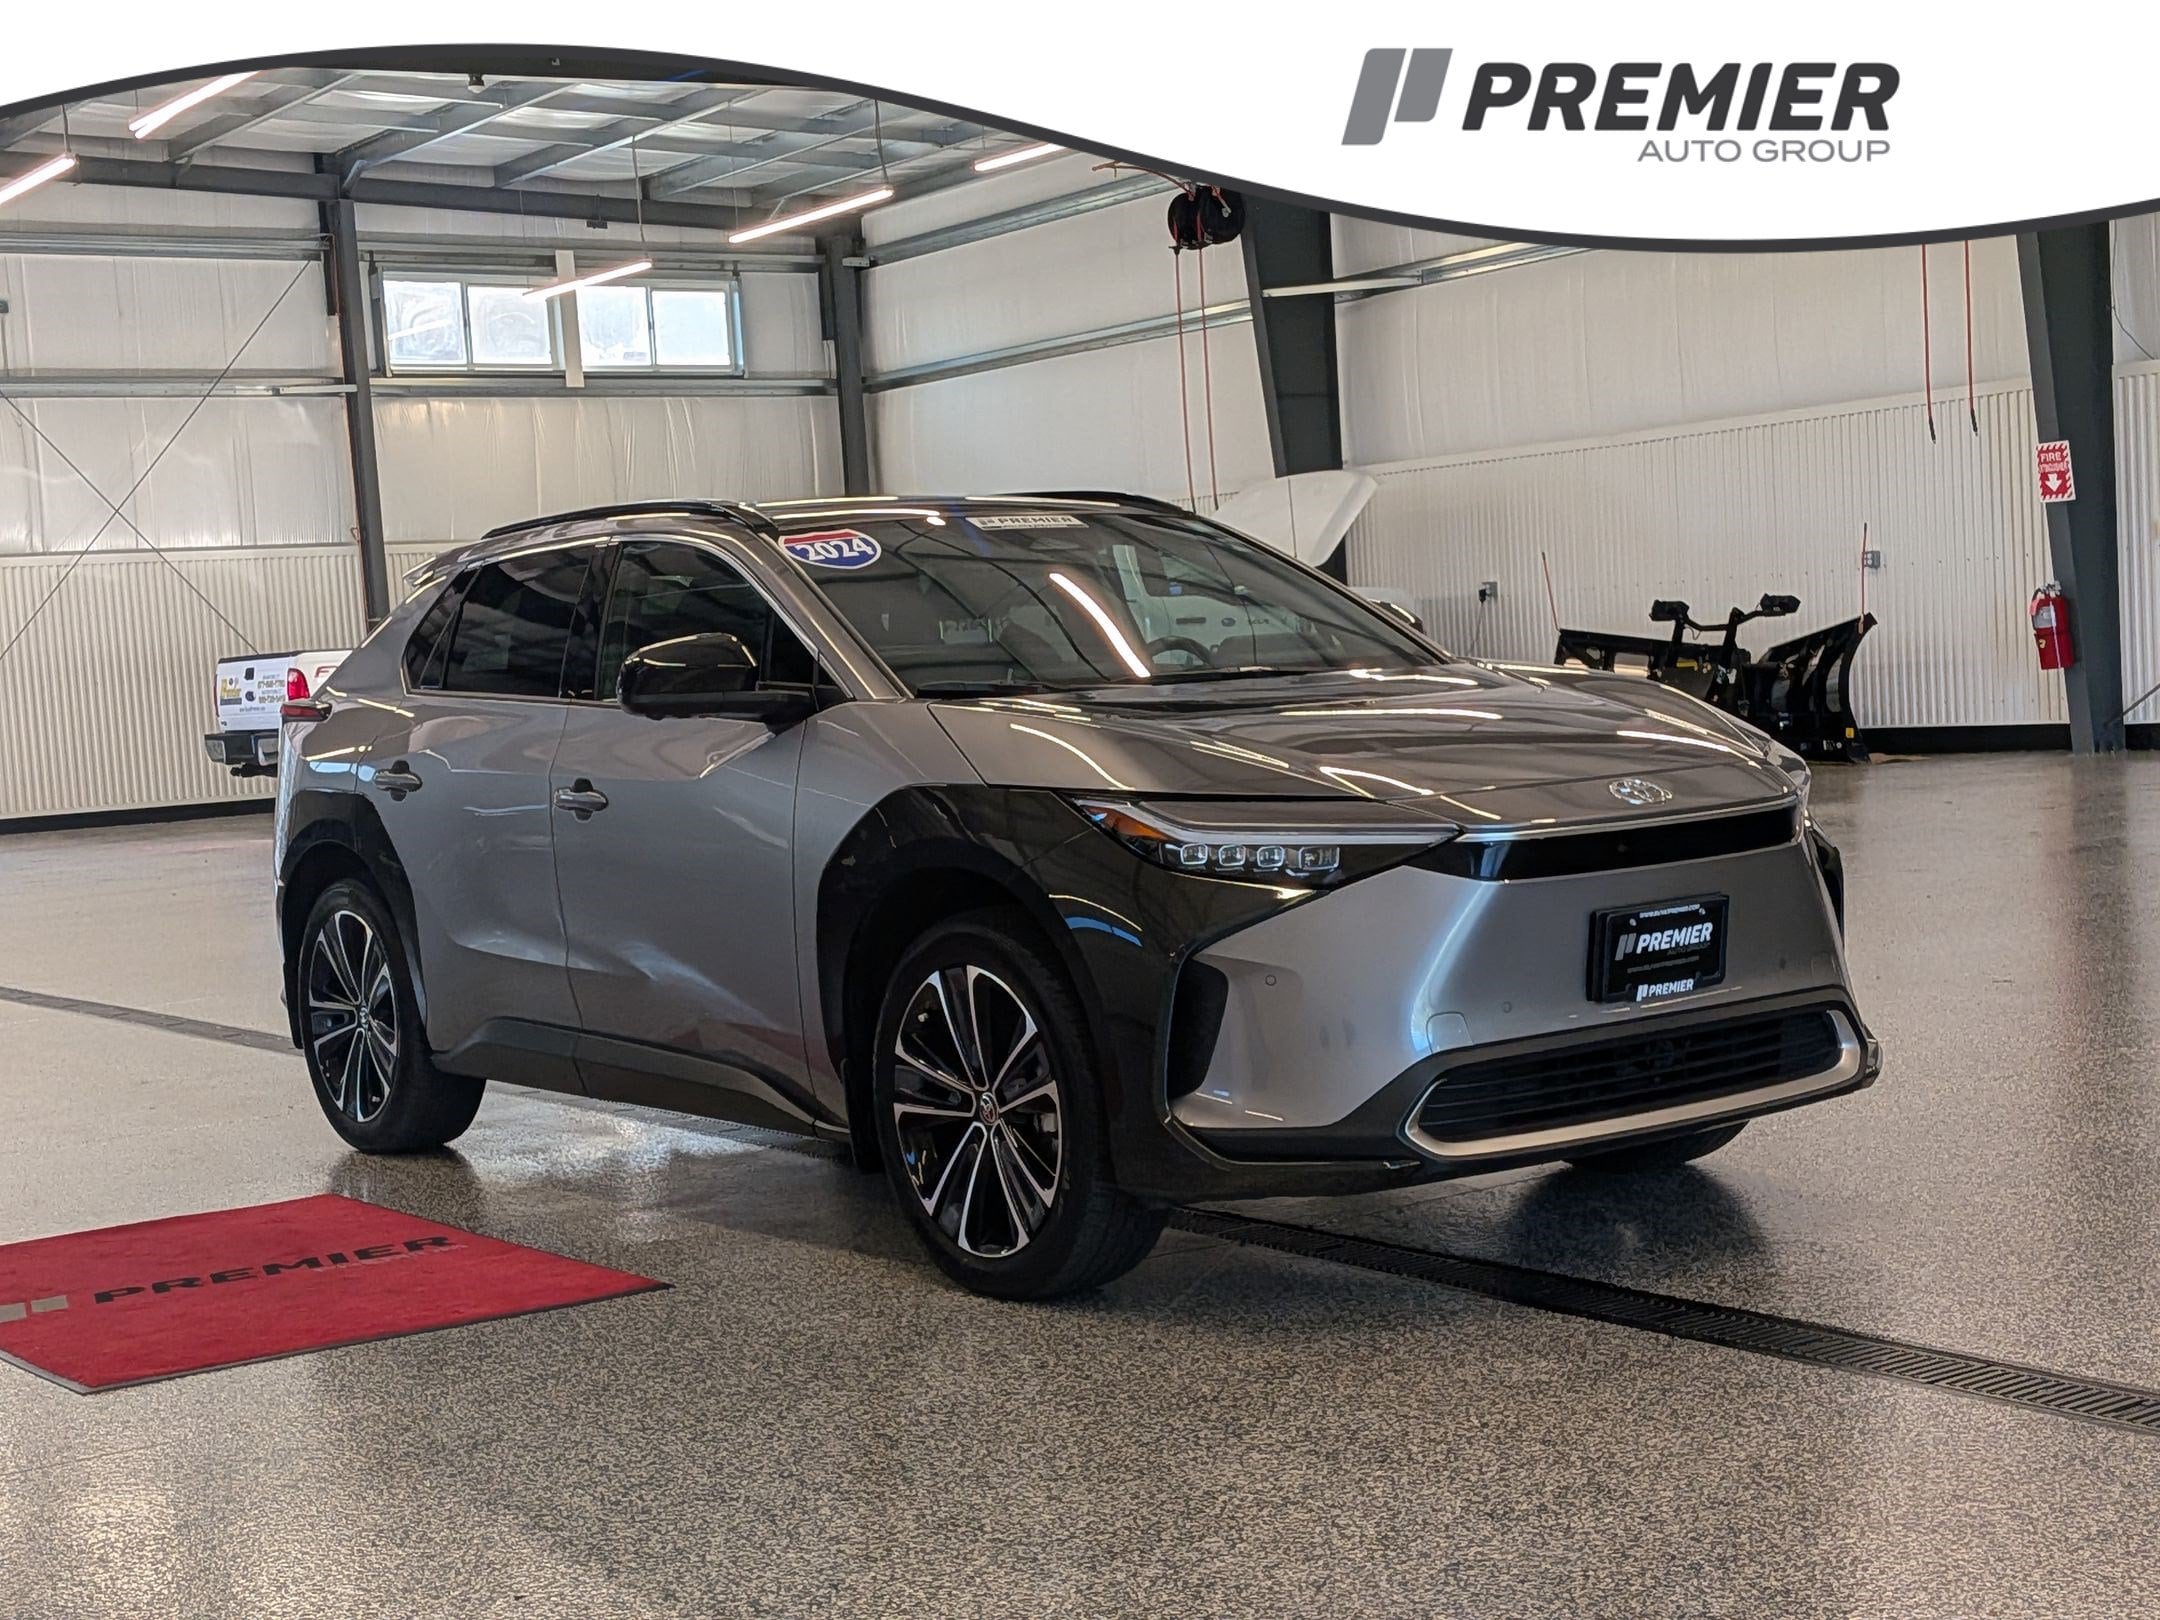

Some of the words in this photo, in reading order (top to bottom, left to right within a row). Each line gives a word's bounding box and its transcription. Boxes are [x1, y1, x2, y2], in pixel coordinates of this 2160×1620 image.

[2040, 451, 2062, 462] FIRE
[998, 516, 1073, 525] PREMIER
[795, 538, 875, 561] 2024
[1636, 922, 1713, 954] PREMIER
[1648, 979, 1694, 997] PREMIER
[94, 1236, 454, 1304] PREMIER
